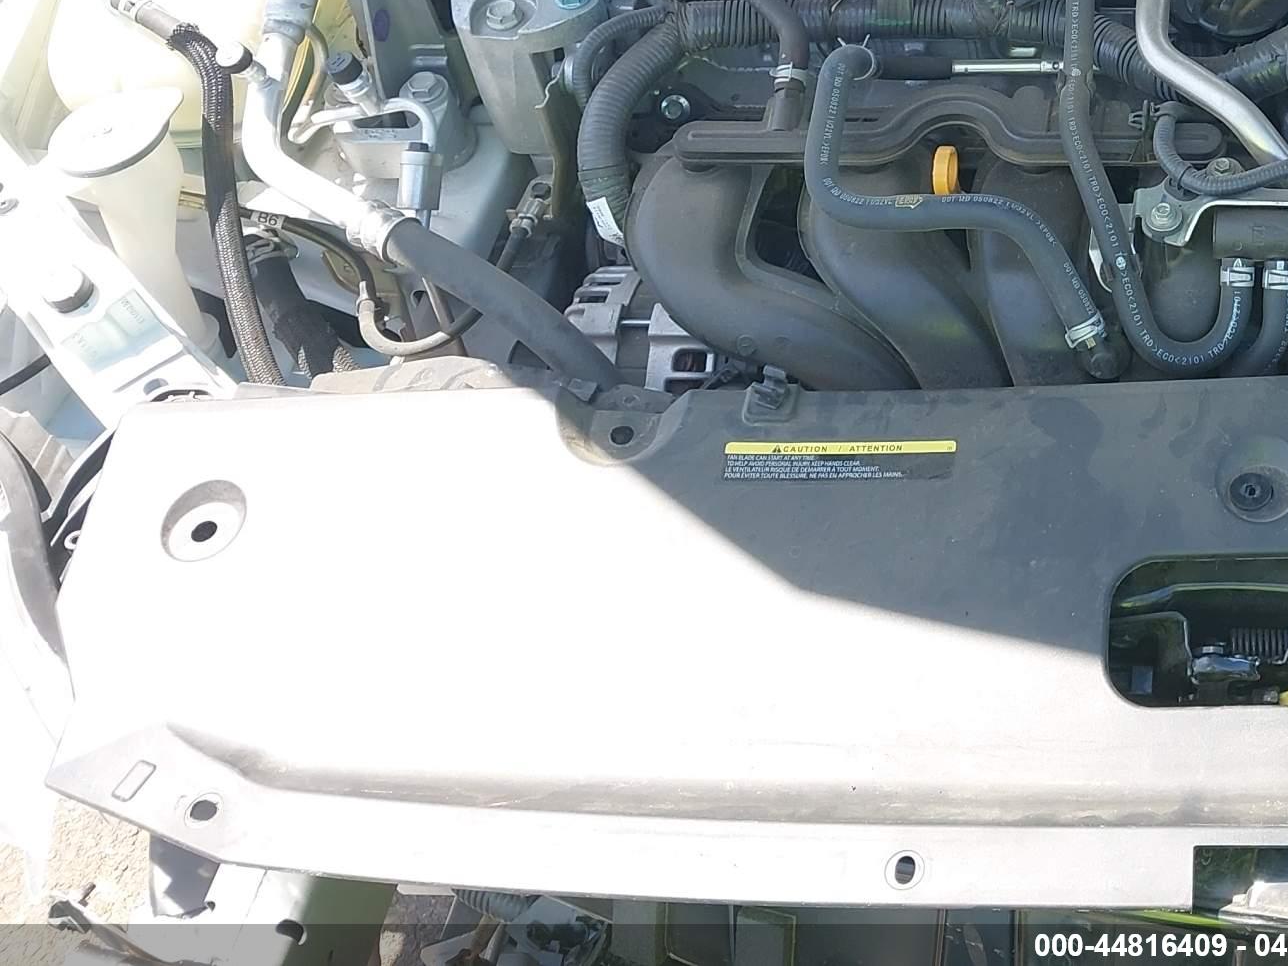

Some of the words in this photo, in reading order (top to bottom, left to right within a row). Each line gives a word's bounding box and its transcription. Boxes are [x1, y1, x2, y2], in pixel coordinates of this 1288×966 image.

[257, 211, 279, 226] B6
[783, 445, 828, 453] CAUTION
[848, 444, 903, 452] ATTENTION
